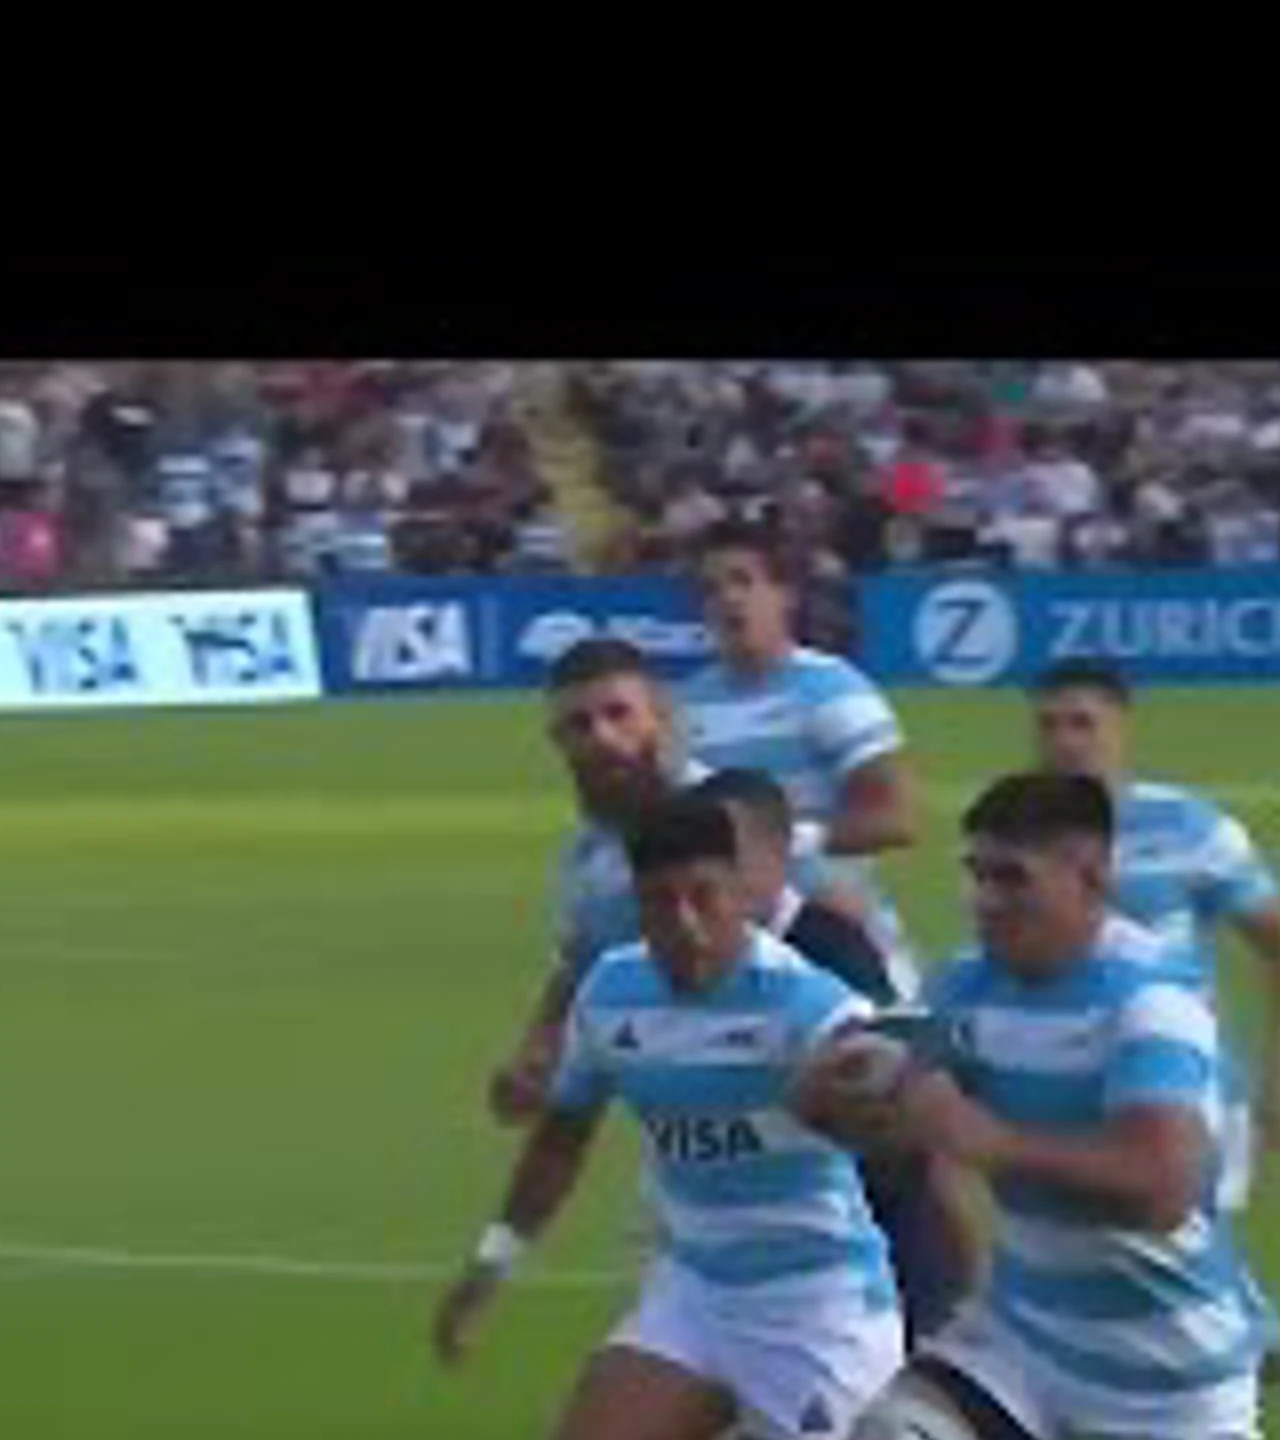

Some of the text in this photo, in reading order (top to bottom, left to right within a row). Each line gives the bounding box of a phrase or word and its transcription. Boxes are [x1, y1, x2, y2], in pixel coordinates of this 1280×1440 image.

[8, 616, 140, 694] VISA
[170, 612, 300, 685] VISA
[932, 600, 995, 663] Z
[650, 1118, 762, 1162] VISA
